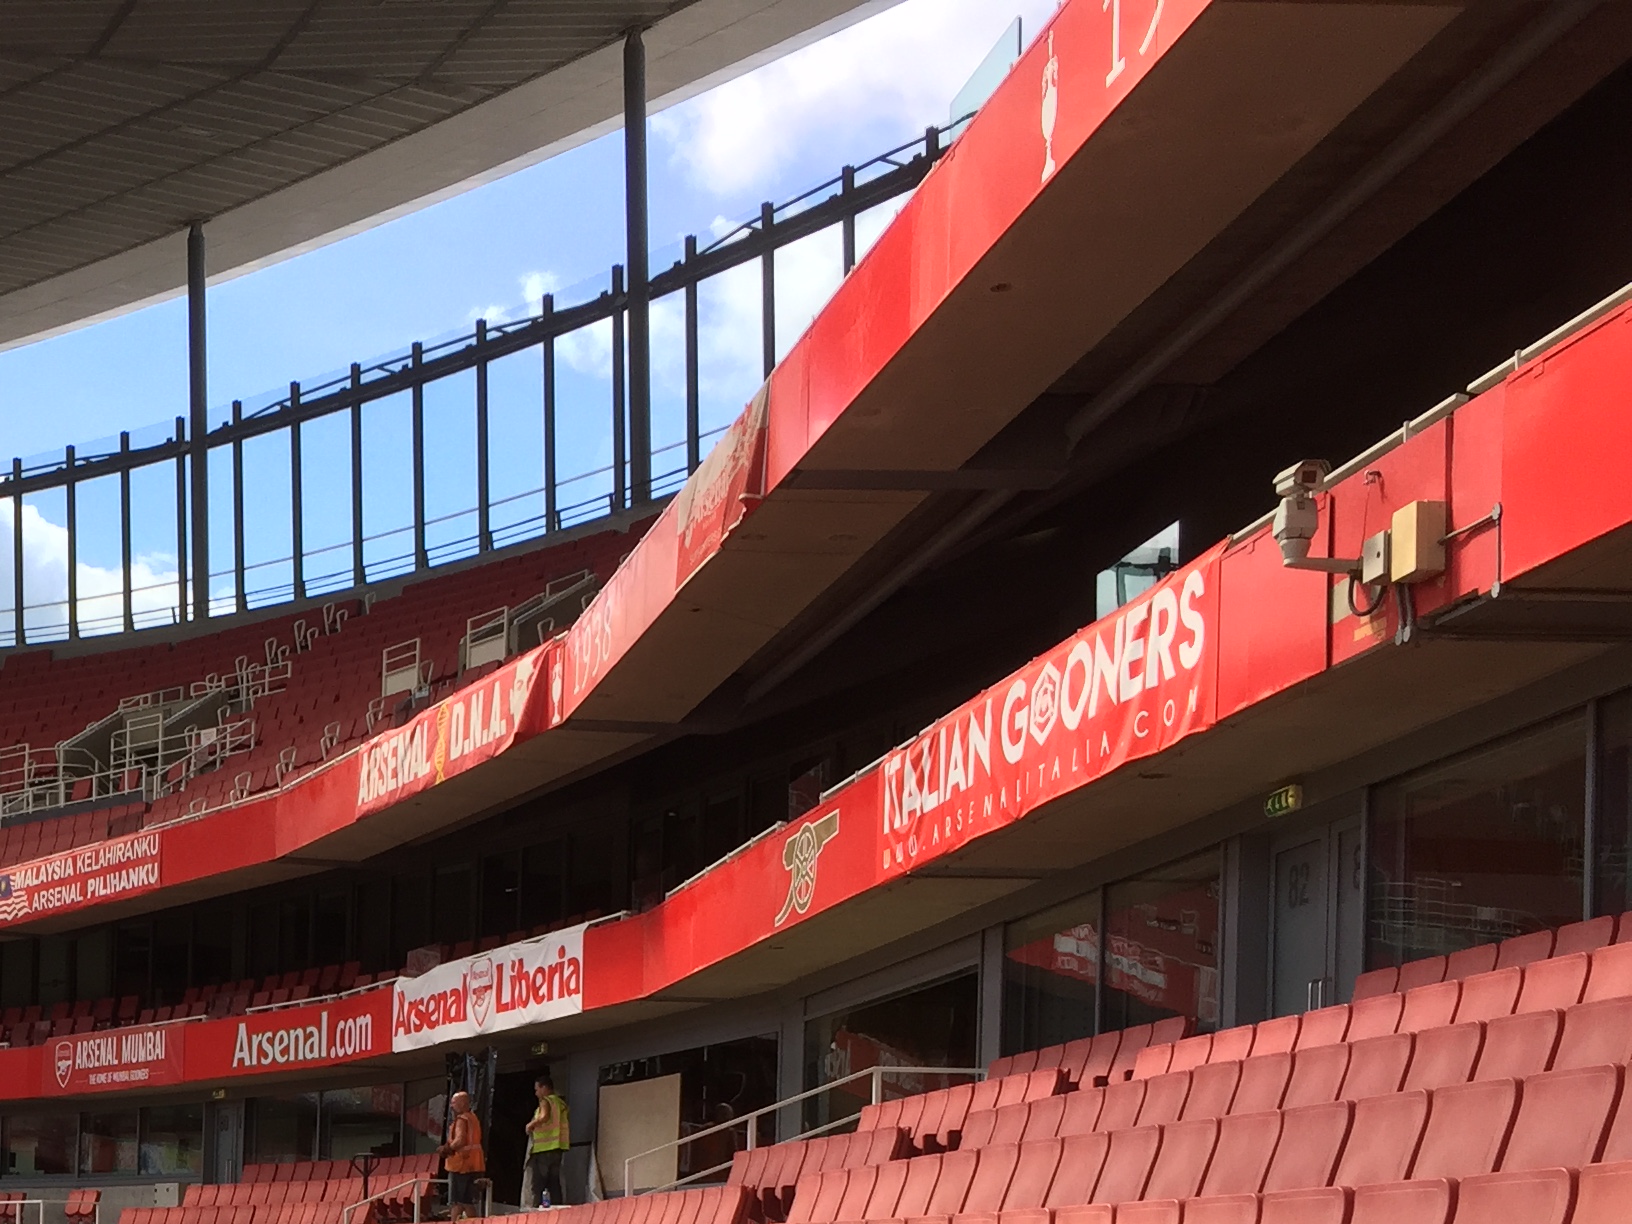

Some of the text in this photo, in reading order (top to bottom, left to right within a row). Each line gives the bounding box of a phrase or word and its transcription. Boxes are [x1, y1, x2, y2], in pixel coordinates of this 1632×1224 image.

[573, 600, 612, 696] 1938
[357, 680, 507, 807] ARSENAL D.N.A.
[883, 697, 993, 835] ITALIAN
[14, 833, 159, 890] MALAYSIA KELAHIRANKU
[32, 862, 158, 912] ARSENAL PILIHANKU
[1288, 862, 1310, 909] 82
[393, 944, 580, 1037] Arsenal Liberia
[75, 1029, 166, 1070] ARSENAL MUMBAI
[232, 1011, 372, 1068] Arsenal.com
